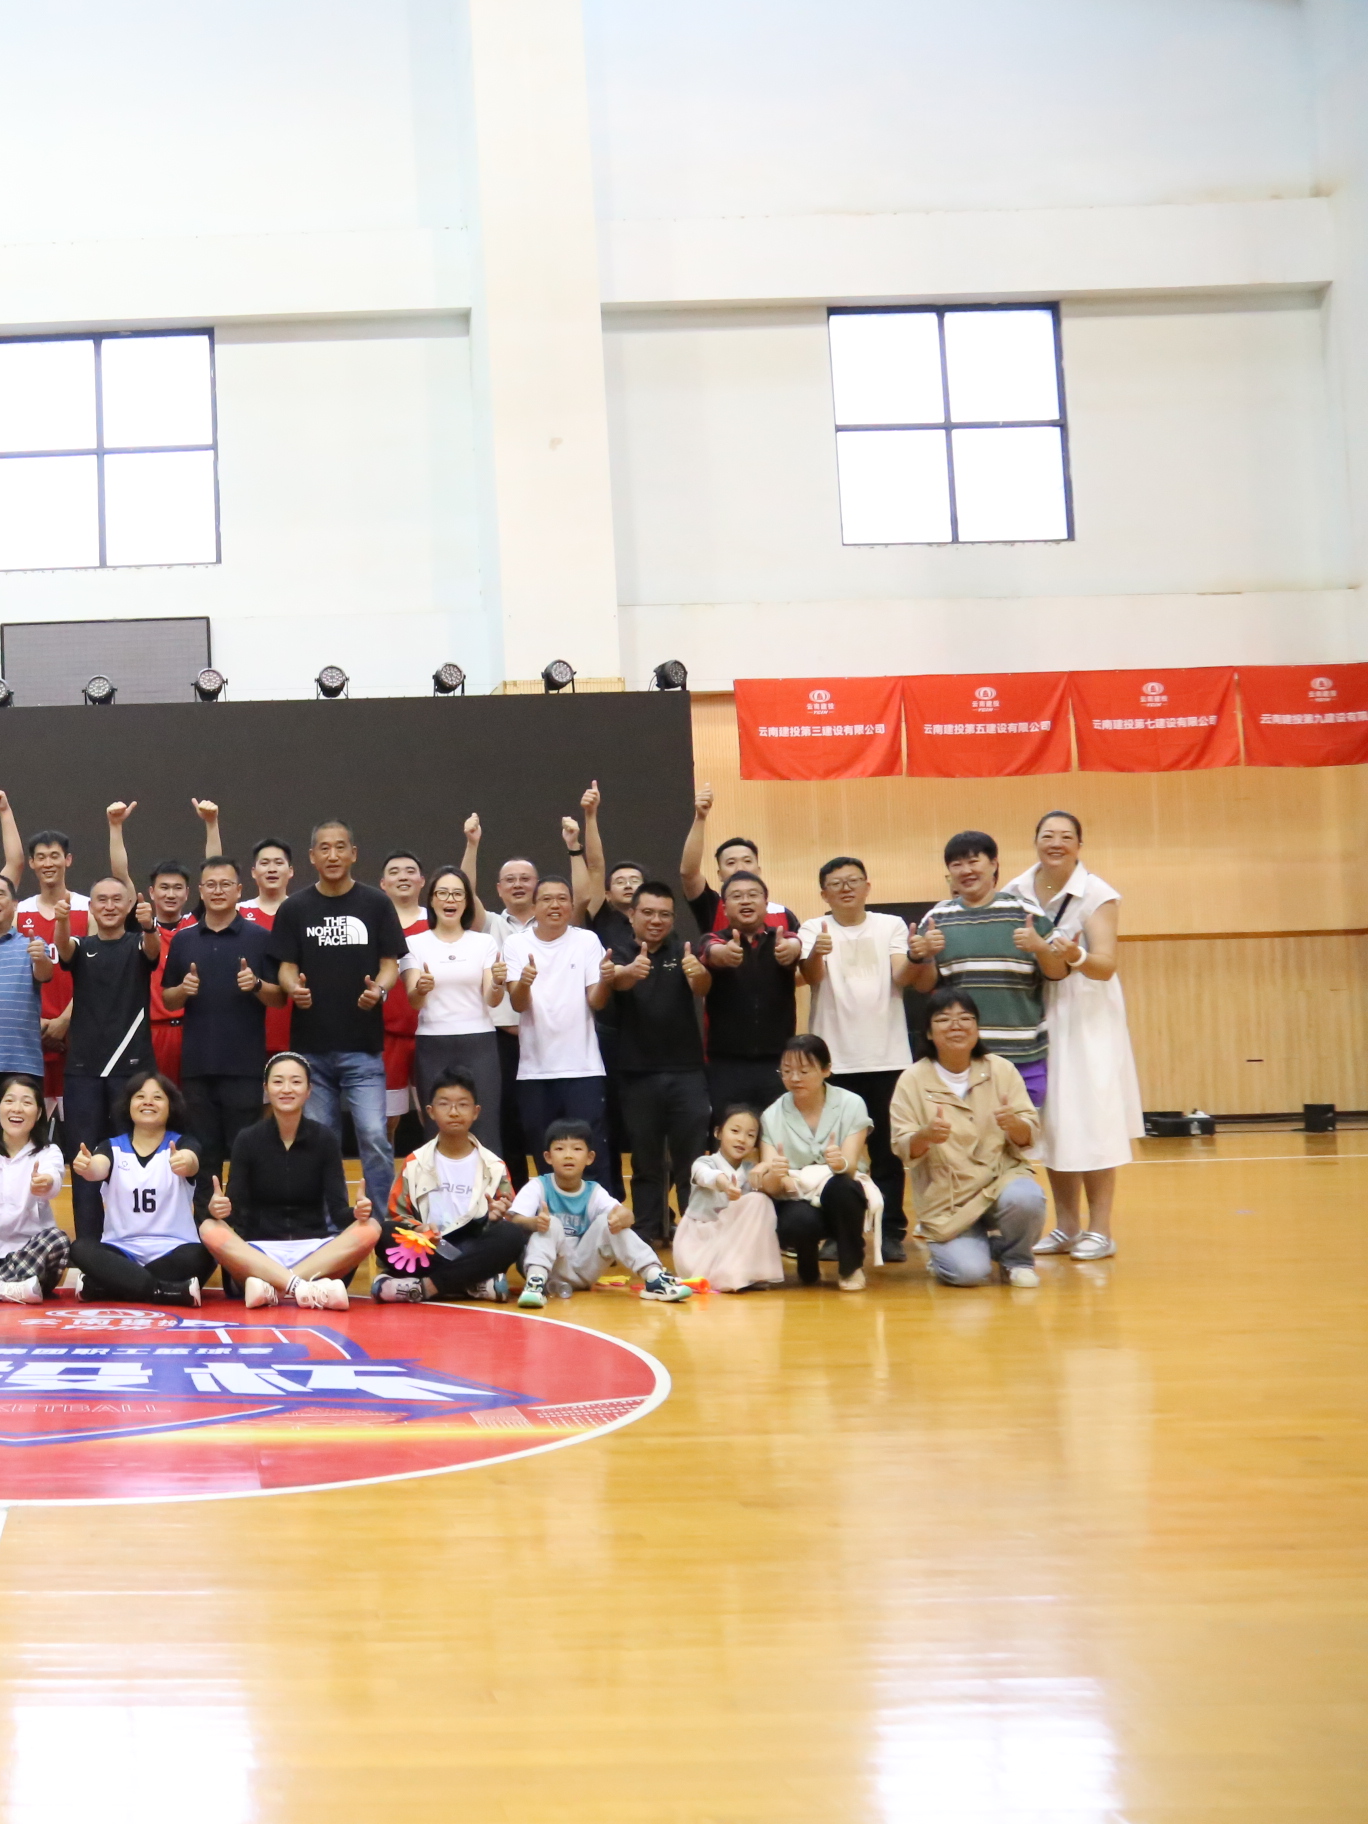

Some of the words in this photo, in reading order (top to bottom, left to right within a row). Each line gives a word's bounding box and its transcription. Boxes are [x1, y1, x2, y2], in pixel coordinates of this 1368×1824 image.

[758, 723, 886, 737] 云南建投第三建设有限公司
[923, 720, 1052, 735] 云南建投第五建设有限公司
[323, 916, 346, 927] THE
[306, 926, 346, 937] NORTH
[318, 935, 347, 946] FACE
[132, 1187, 156, 1213] 16
